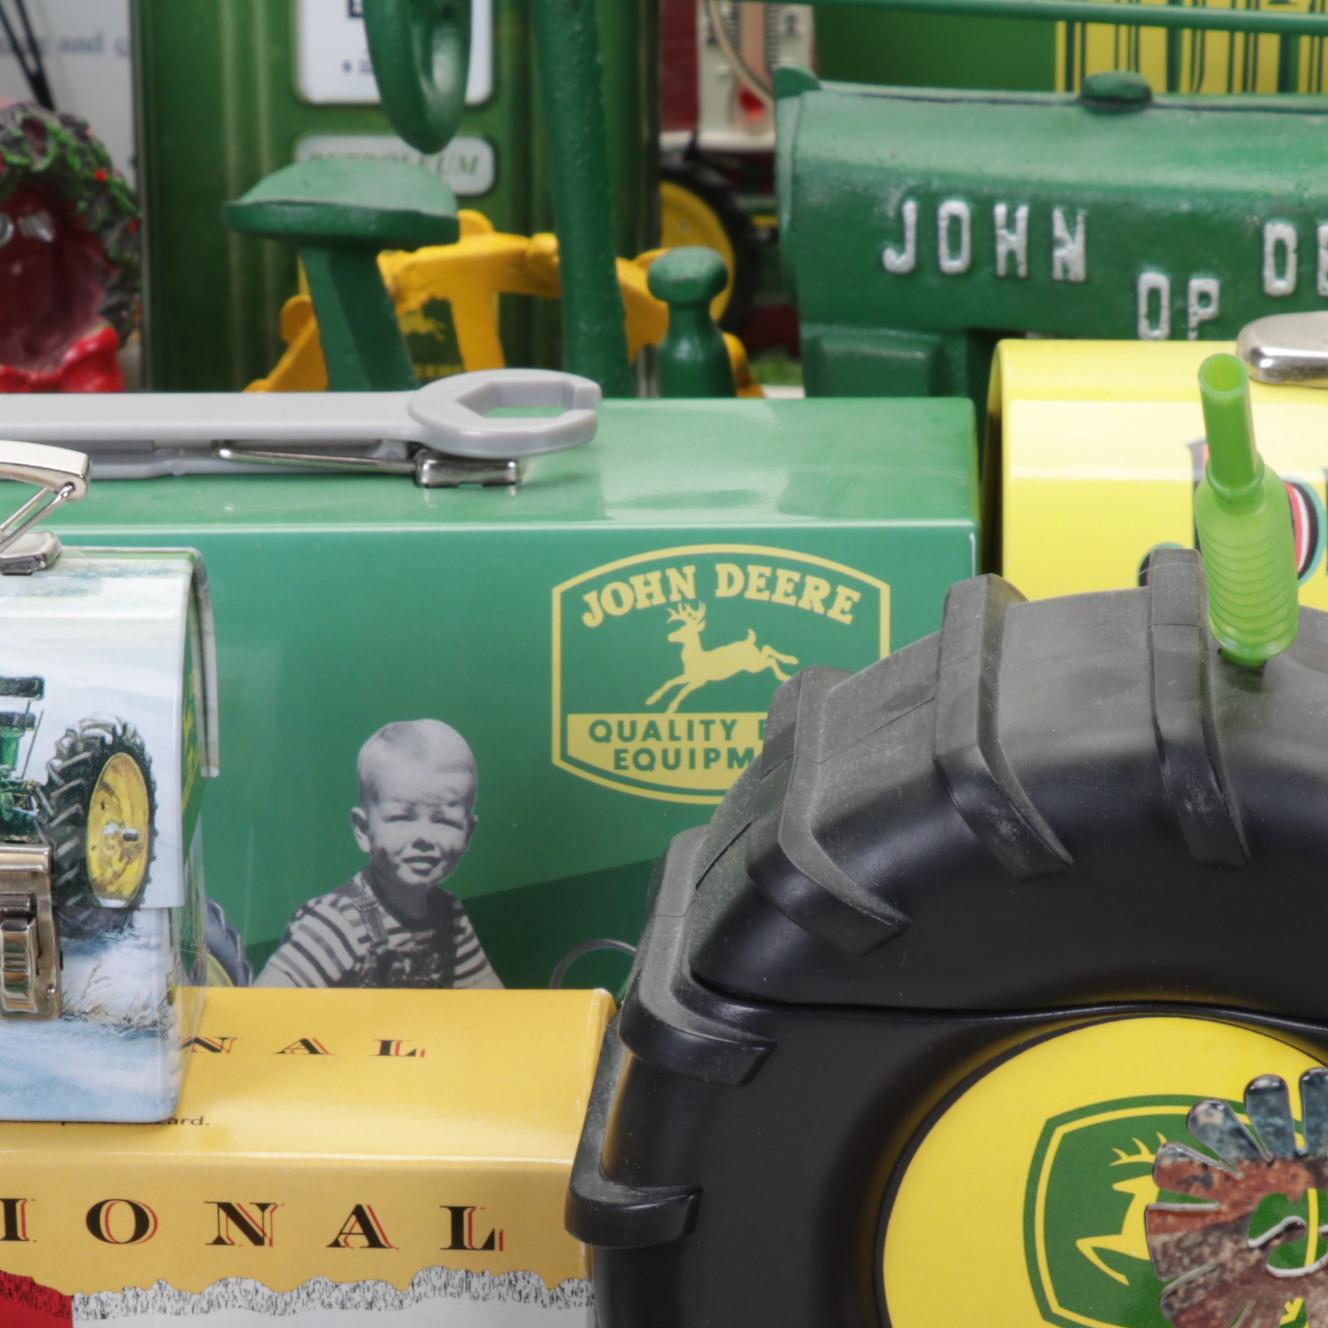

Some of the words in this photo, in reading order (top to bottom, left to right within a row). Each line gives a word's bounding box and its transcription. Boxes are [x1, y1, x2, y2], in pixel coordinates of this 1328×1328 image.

[883, 200, 1087, 284] JOHN
[582, 565, 696, 628] JOHN
[715, 563, 861, 625] DEERE
[588, 719, 738, 744] QUALITY
[613, 747, 755, 772] EQUIPM
